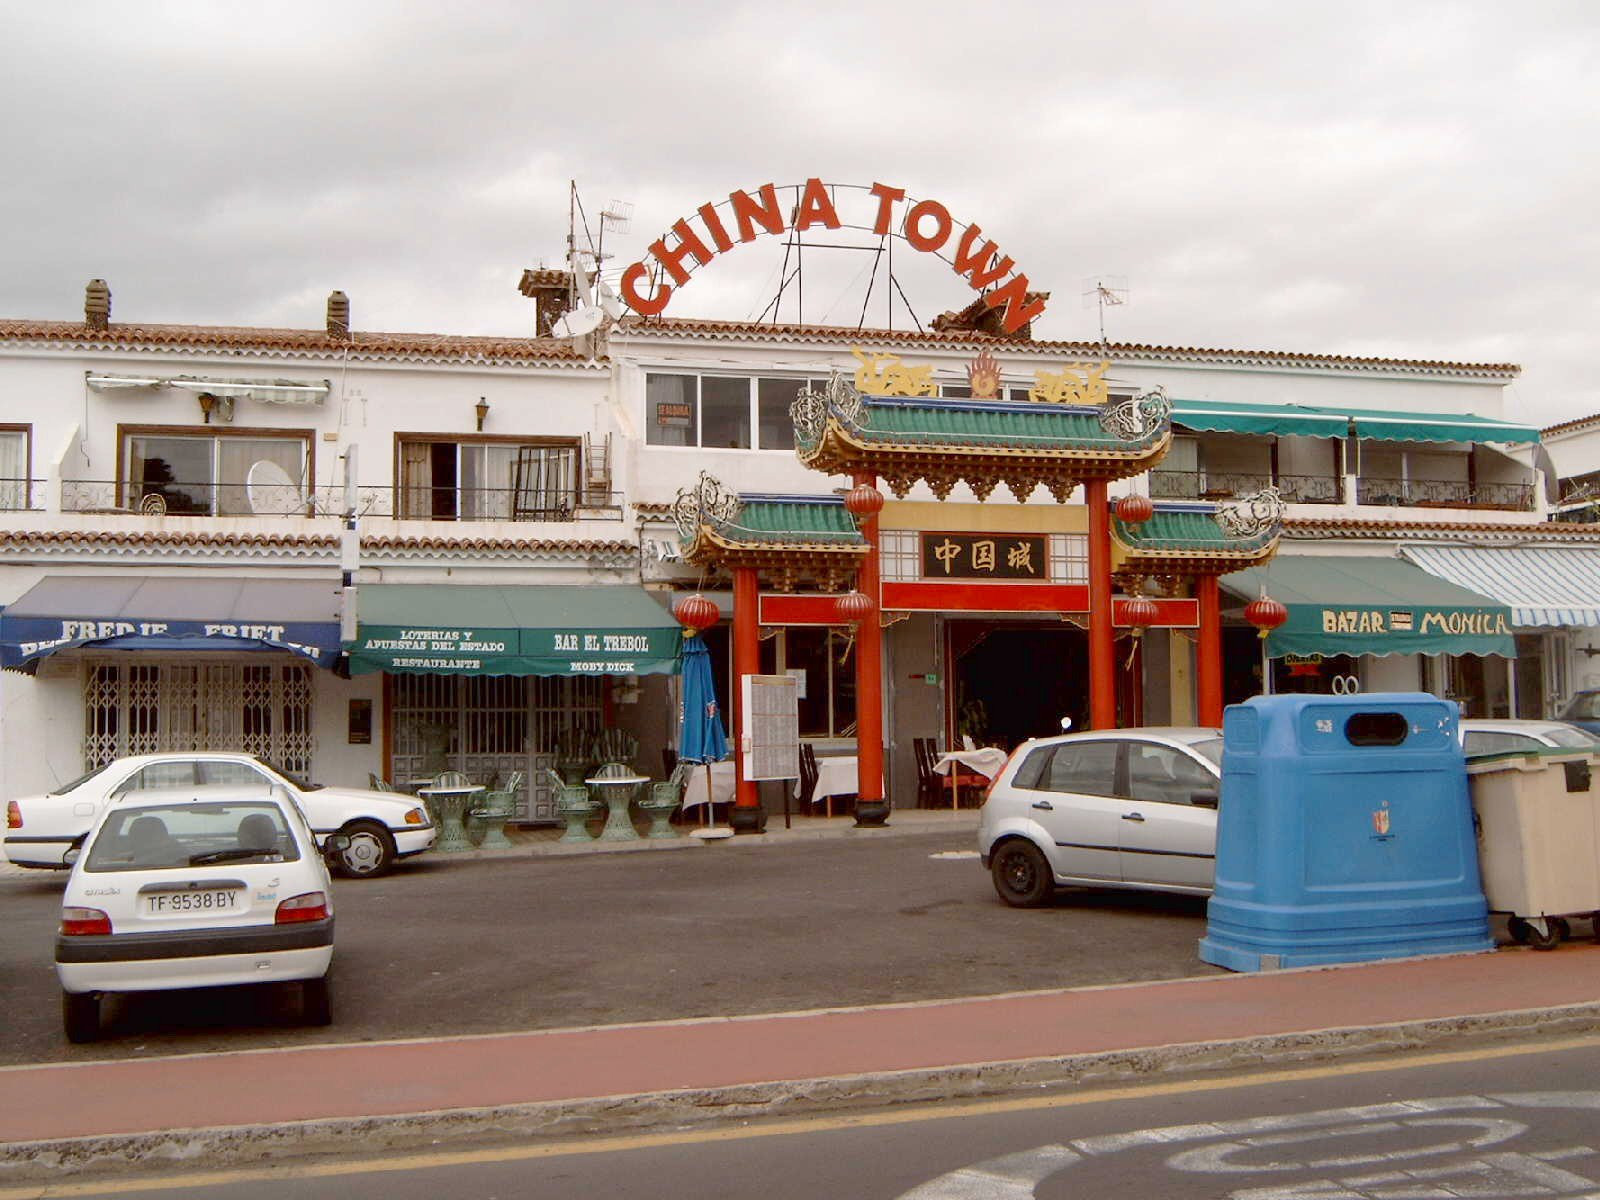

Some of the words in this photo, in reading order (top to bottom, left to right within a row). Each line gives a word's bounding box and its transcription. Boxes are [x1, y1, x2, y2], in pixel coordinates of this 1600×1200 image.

[620, 178, 840, 316] CHINA
[870, 182, 1046, 334] TOWN
[934, 538, 1034, 574] 中国城
[1322, 609, 1387, 633] BAZAR
[400, 630, 460, 640] LOTERIAS
[464, 631, 473, 641] Y
[554, 634, 579, 651] BAR
[584, 634, 600, 652] EL
[603, 635, 649, 653] TREBOL
[364, 639, 427, 650] APUESTAS
[431, 641, 455, 651] DEL
[459, 641, 505, 652] ESTADO
[391, 658, 481, 669] RESTAURANTE
[570, 661, 604, 672] MOBY
[606, 662, 635, 672] DICK
